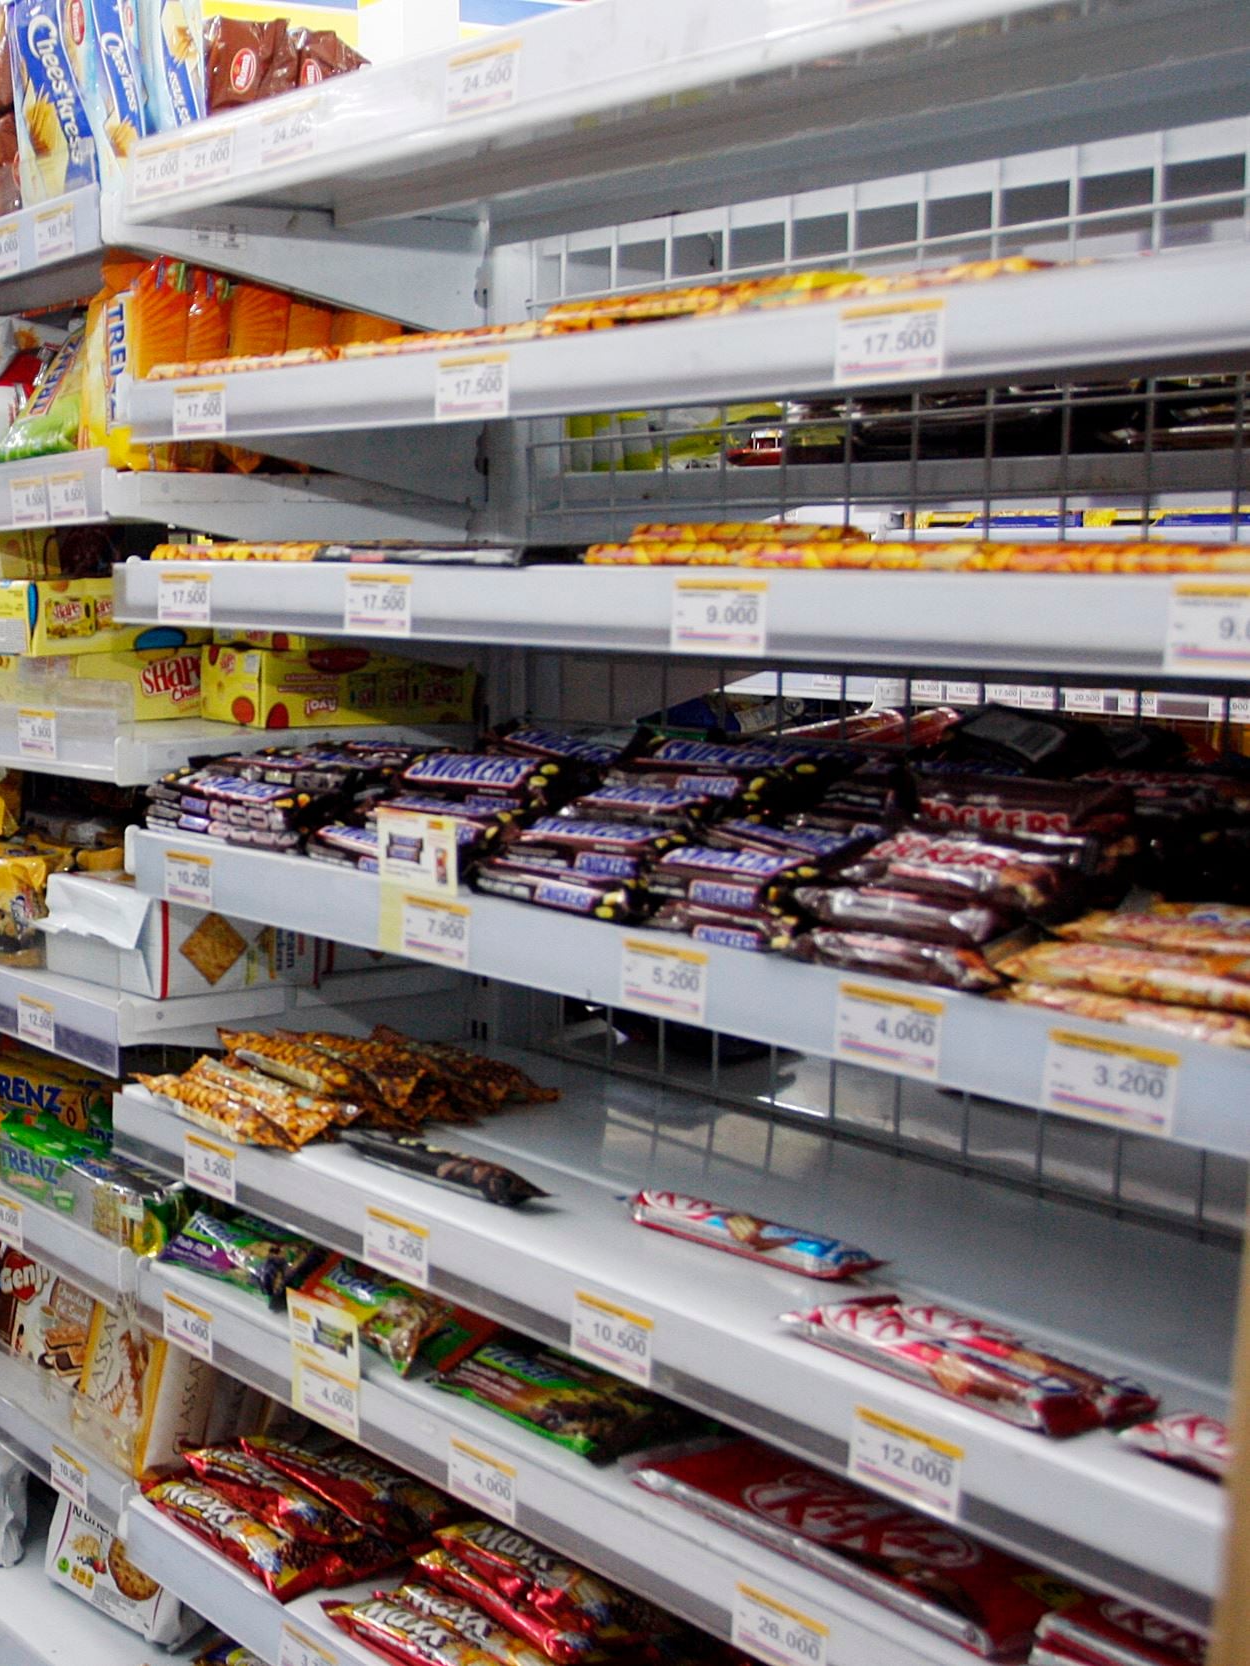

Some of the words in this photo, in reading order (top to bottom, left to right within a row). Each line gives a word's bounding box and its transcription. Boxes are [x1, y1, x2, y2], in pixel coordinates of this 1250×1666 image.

[461, 65, 513, 93] 24.500
[145, 159, 179, 180] 21.000
[193, 145, 230, 169] 21.000
[862, 328, 937, 356] 17.500
[453, 376, 503, 397] 17.500
[186, 401, 223, 418] 17.500
[171, 590, 207, 606] 17.500
[362, 594, 406, 612] 17.500
[705, 603, 759, 627] 9.000
[691, 881, 758, 907] SNICKERS
[427, 916, 465, 941] 7.900
[651, 964, 701, 993] 5.200
[874, 1016, 937, 1048] 4.000
[1092, 1062, 1166, 1099] 3.200
[202, 1156, 232, 1180] 5.200
[386, 1234, 423, 1262] 5.200
[592, 1321, 647, 1357] 10.500
[322, 1387, 354, 1413] 4.000
[879, 1440, 952, 1487] 12.000
[474, 1472, 513, 1501] 4.000
[163, 1481, 235, 1525] Maxx
[471, 1524, 556, 1572] Maxx
[405, 1585, 493, 1637] Maxx
[363, 1602, 449, 1649] Maxx
